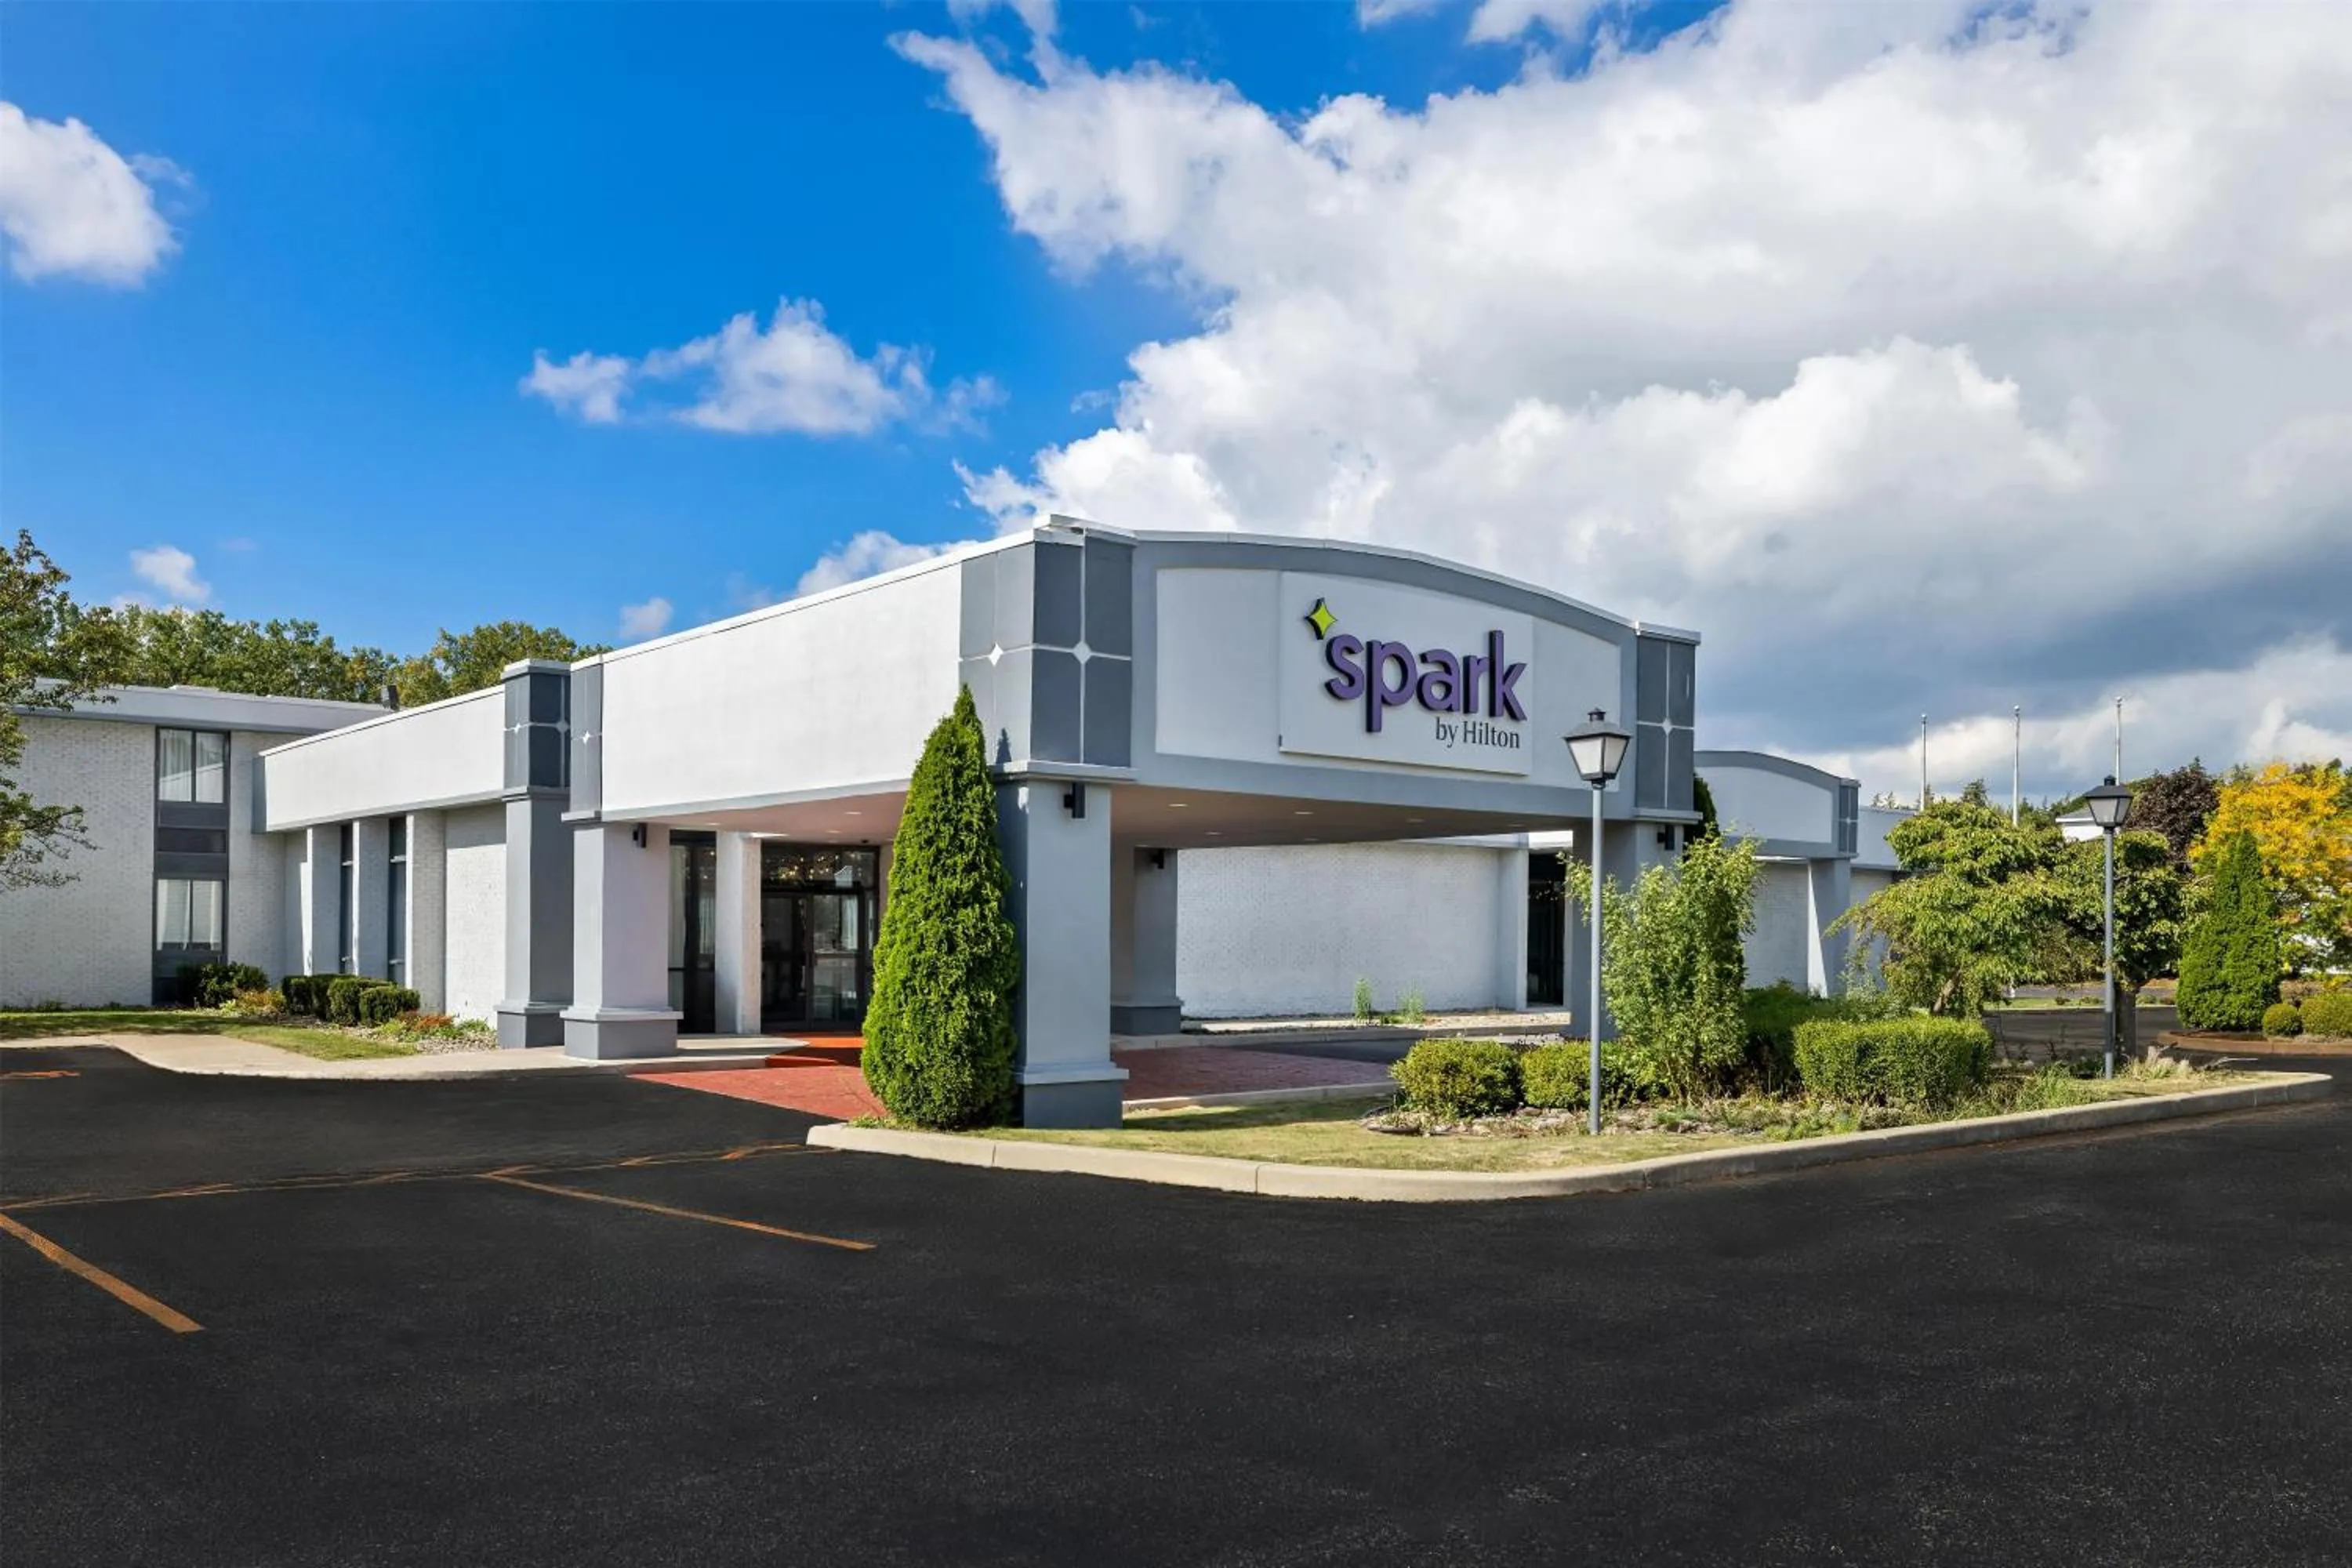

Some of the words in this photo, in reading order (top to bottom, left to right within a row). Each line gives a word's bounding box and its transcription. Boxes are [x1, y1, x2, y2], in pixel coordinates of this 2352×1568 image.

[1324, 630, 1527, 732] spark
[1435, 717, 1458, 748] by
[1463, 720, 1520, 749] Hilton
